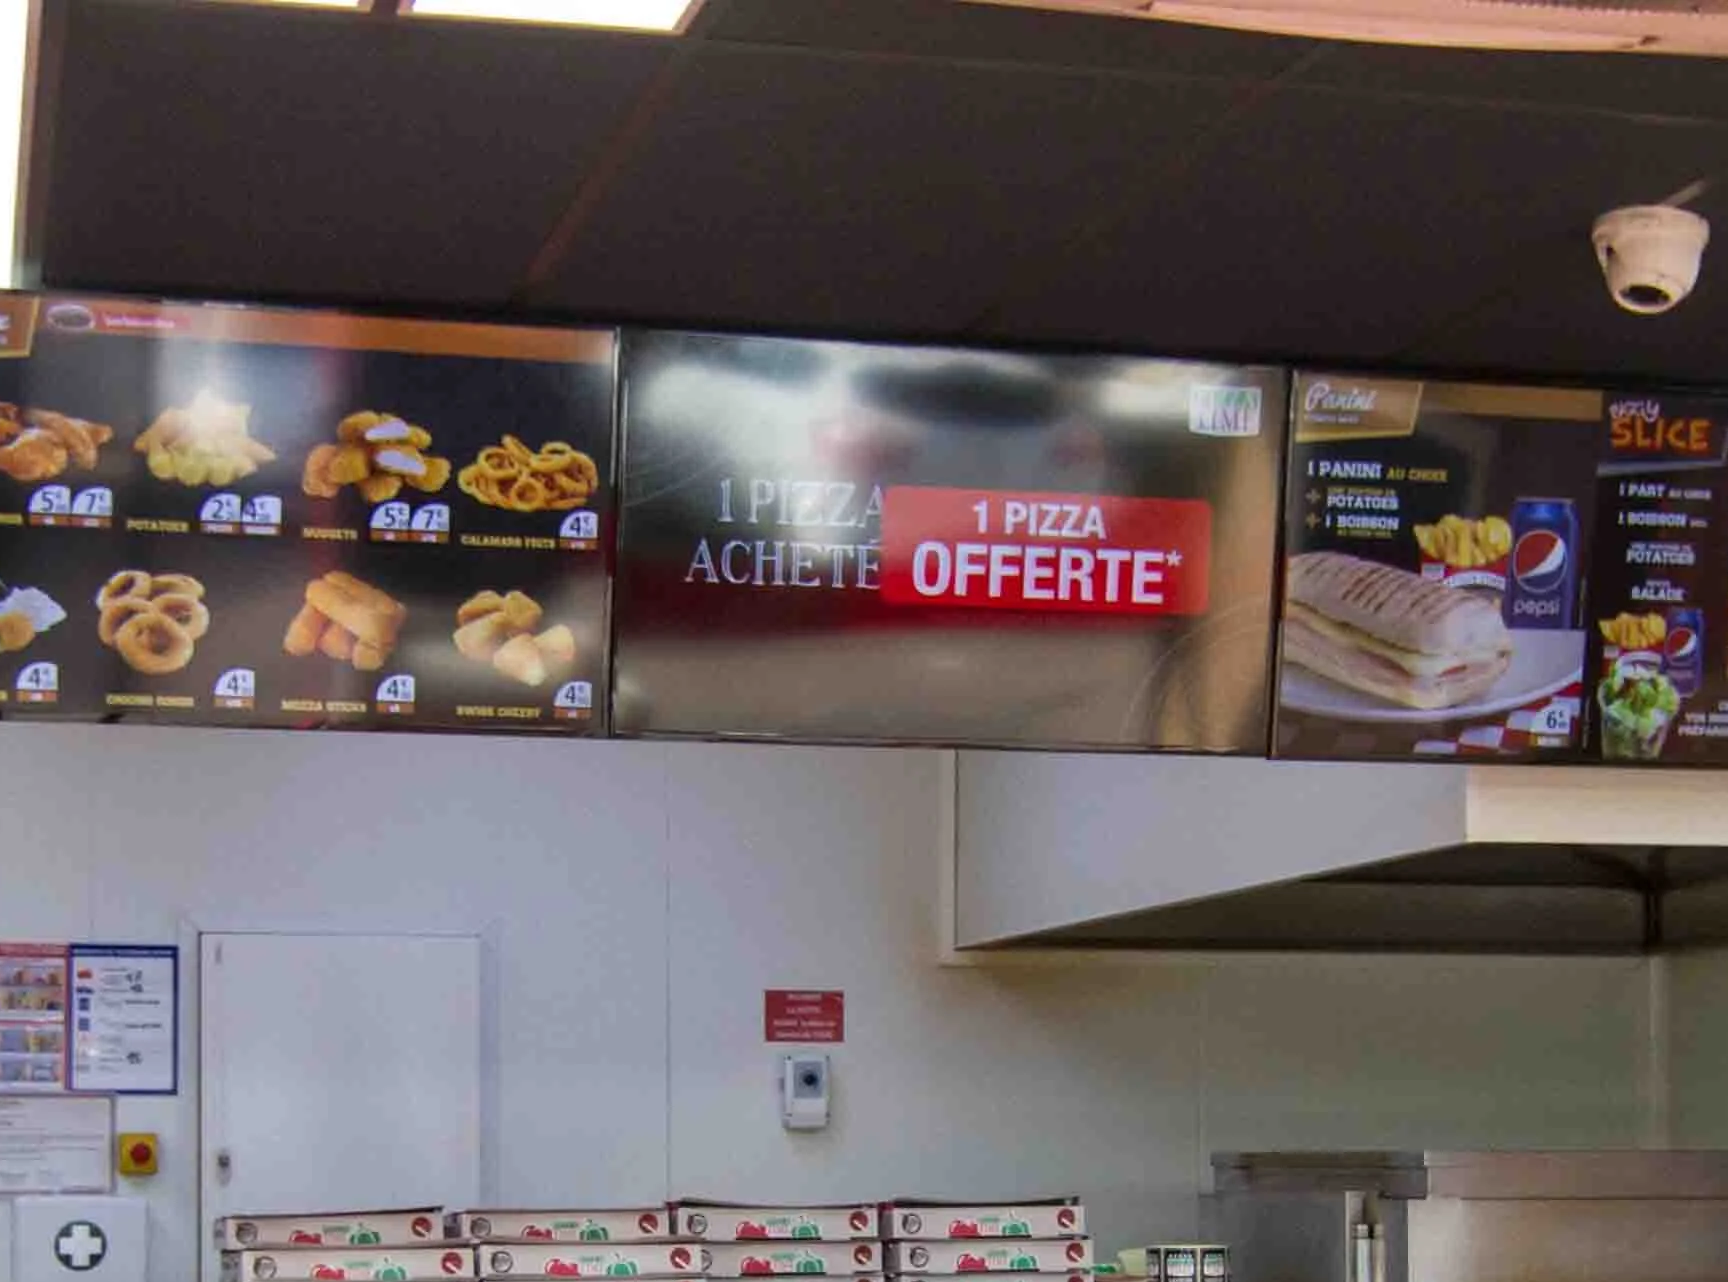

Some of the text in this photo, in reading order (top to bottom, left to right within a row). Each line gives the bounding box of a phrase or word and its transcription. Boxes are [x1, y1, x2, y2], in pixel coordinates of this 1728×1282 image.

[1612, 416, 1711, 450] SLICE
[1319, 460, 1382, 479] PANINI
[748, 481, 884, 530] PIZZA
[974, 501, 1107, 540] 1 PIZZA
[684, 536, 883, 590] ACHETÉ
[1513, 599, 1560, 618] pepsi
